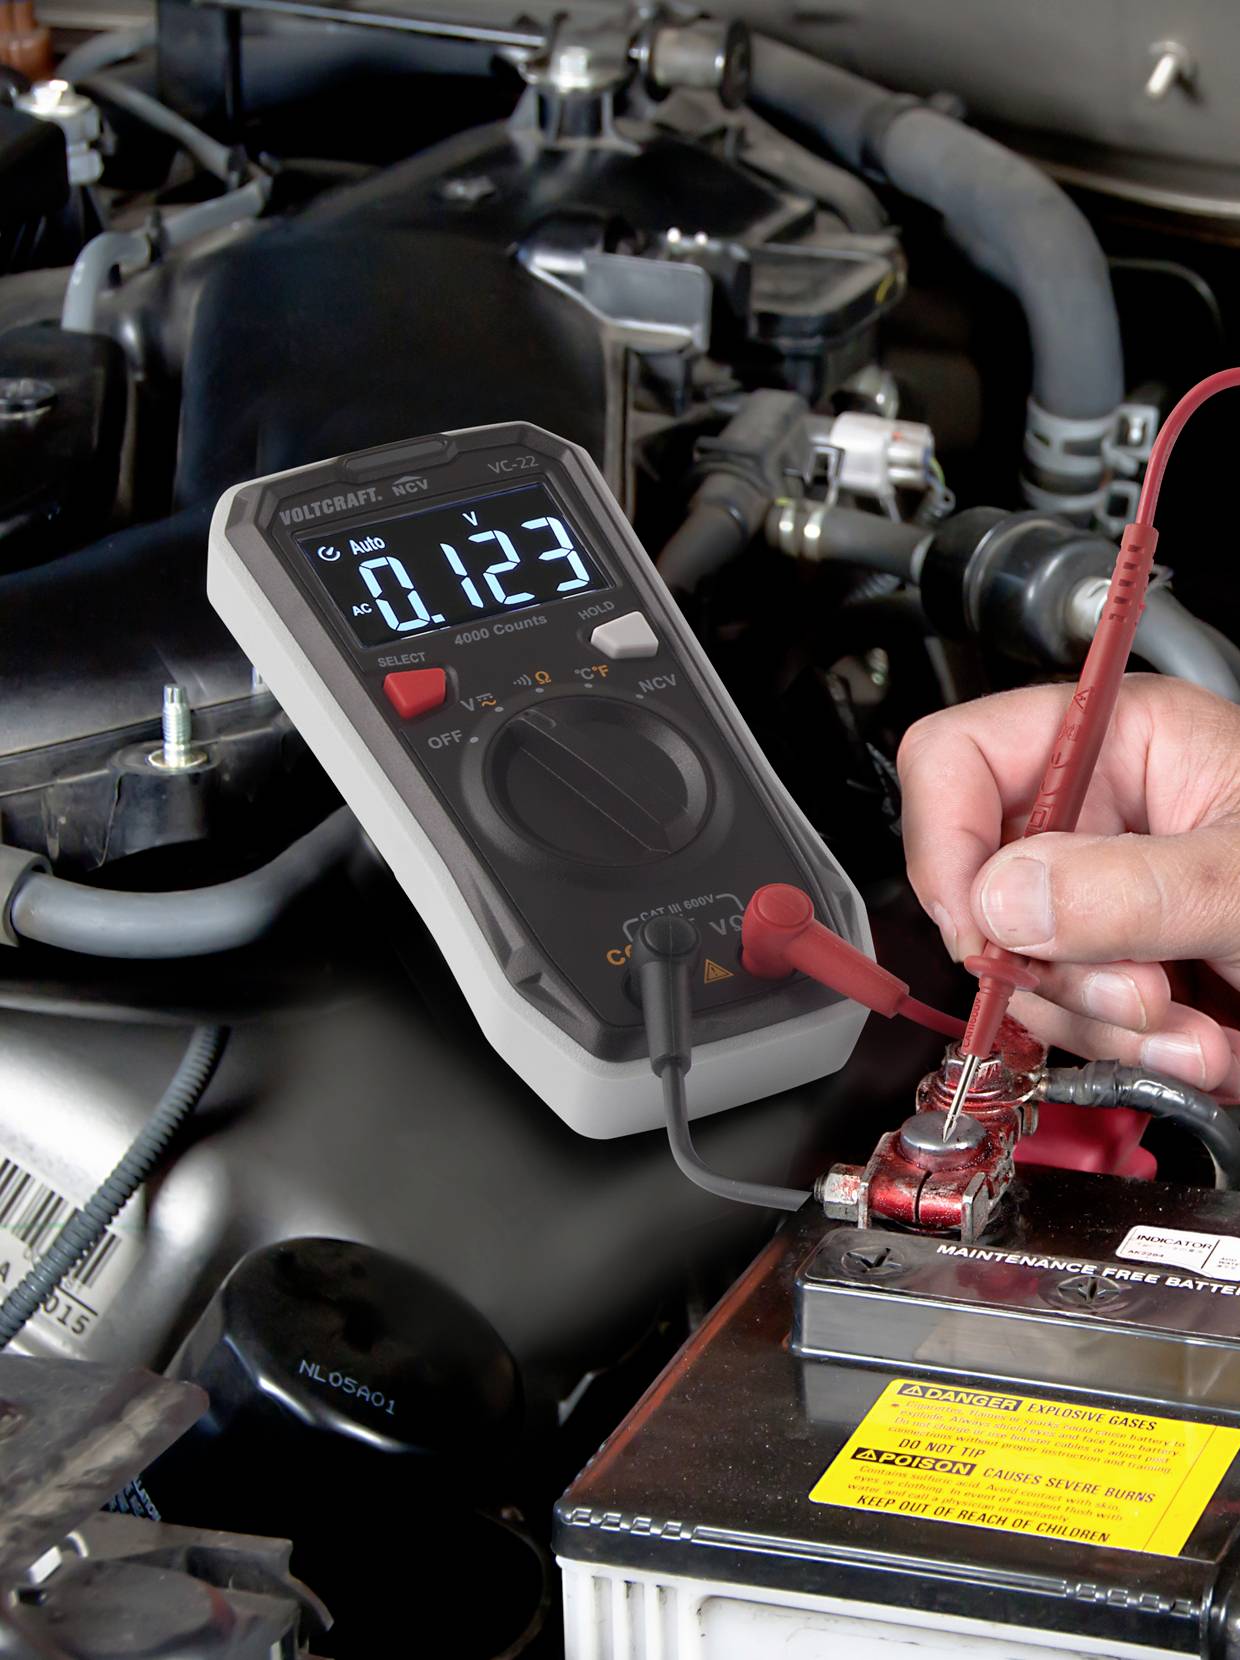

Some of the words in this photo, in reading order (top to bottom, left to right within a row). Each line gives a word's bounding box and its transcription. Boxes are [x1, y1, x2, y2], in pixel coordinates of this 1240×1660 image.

[488, 455, 540, 475] VC-22
[392, 478, 430, 497] NCV
[462, 511, 479, 527] V
[349, 535, 386, 556] Auto
[358, 516, 591, 632] 0.123
[352, 603, 373, 617] AC
[577, 600, 616, 621] HOLD
[454, 627, 490, 647] 4000
[493, 614, 548, 636] Counts
[377, 651, 427, 669] SELECT
[638, 674, 679, 695] NCV
[427, 729, 464, 750] OFF
[685, 894, 715, 910] 600V
[1137, 1234, 1213, 1250] INDICATOR
[936, 1243, 1099, 1276] MAINTENANCE
[1101, 1267, 1160, 1286] FREE
[924, 1388, 1018, 1411] DANGER
[1027, 1403, 1104, 1424] EXPLOSIVE
[1109, 1415, 1158, 1431] GASES
[898, 1438, 920, 1450] DO
[926, 1441, 954, 1454] NOT
[961, 1446, 986, 1459] TIP
[878, 1452, 972, 1476] POISON
[982, 1467, 1043, 1486] CAUSES
[1045, 1477, 1103, 1497] SEVERE
[1104, 1487, 1156, 1504] BURNS
[856, 1494, 896, 1509] KEEP
[898, 1500, 933, 1514] OUT
[934, 1506, 955, 1518] OF
[957, 1509, 1008, 1526] REACH
[1011, 1518, 1032, 1530] OF
[1035, 1521, 1111, 1543] CHILDREN
